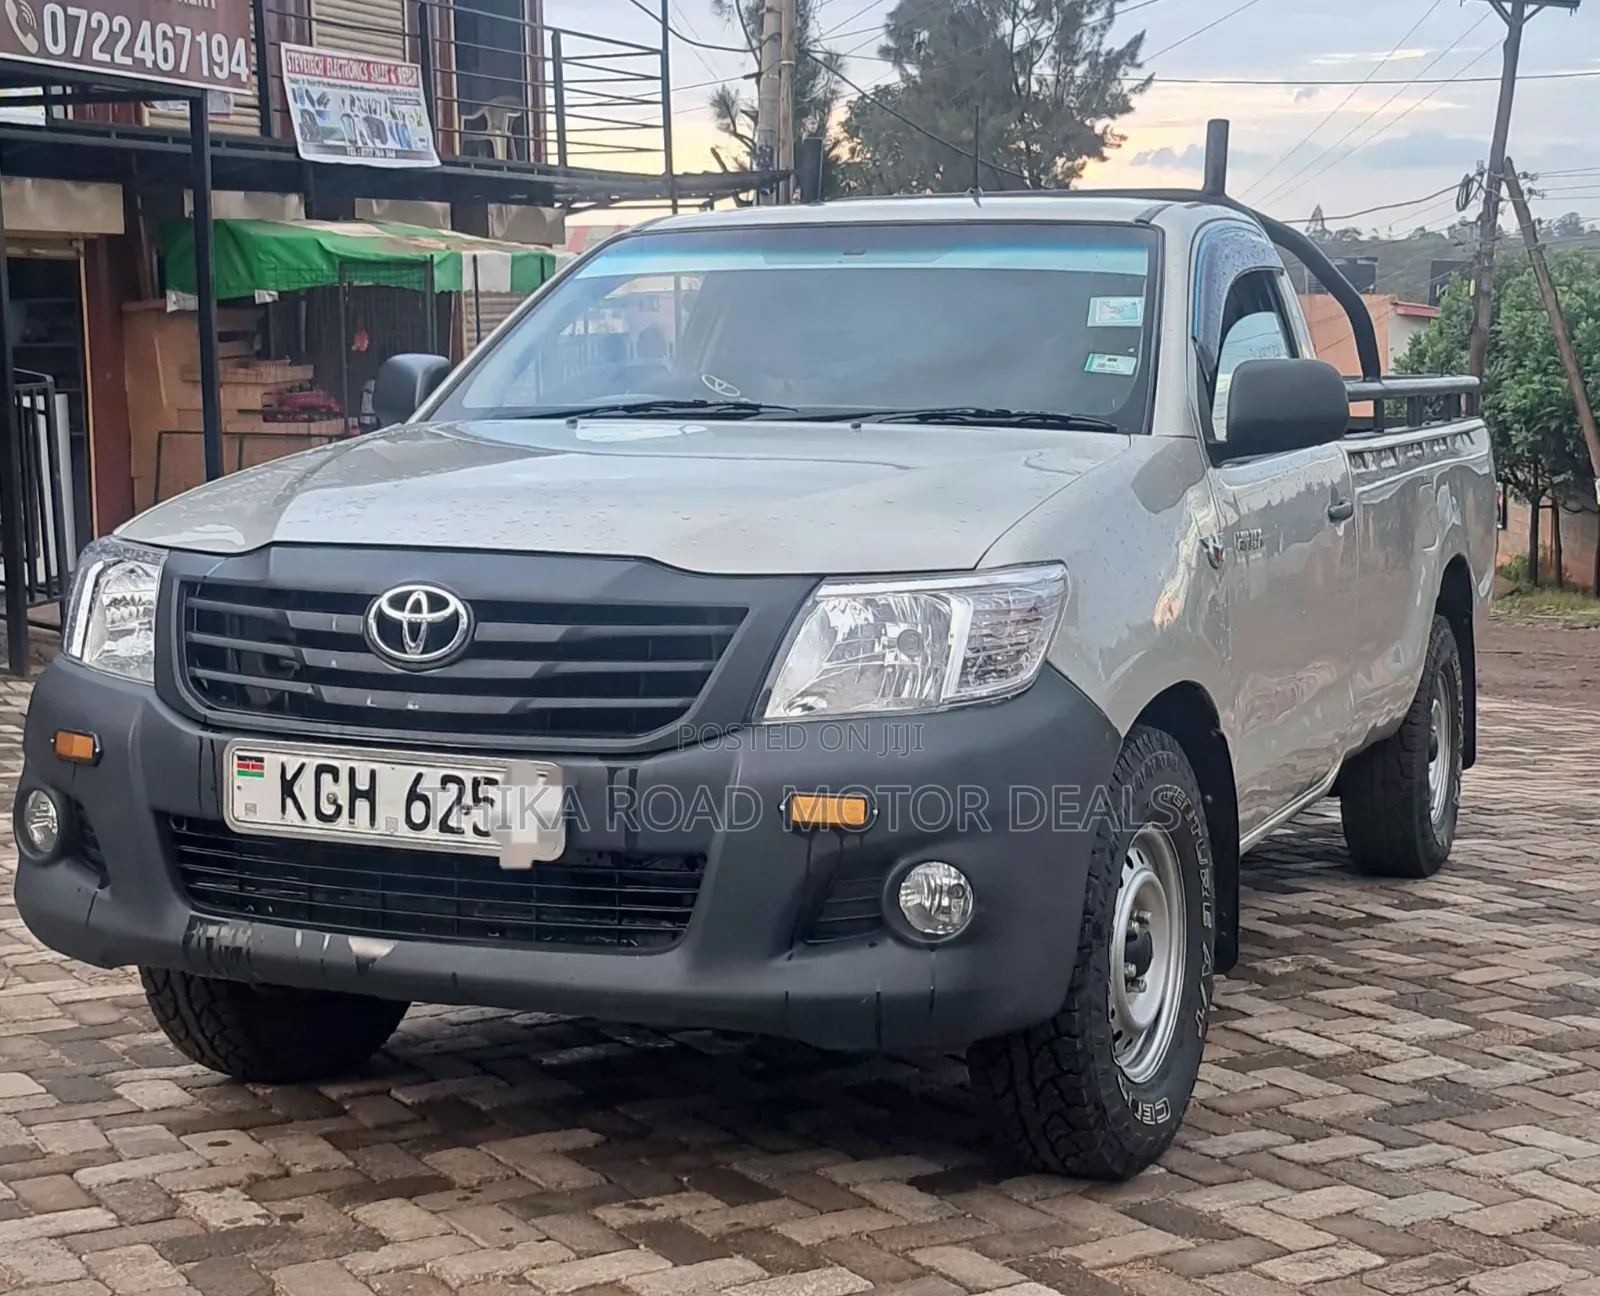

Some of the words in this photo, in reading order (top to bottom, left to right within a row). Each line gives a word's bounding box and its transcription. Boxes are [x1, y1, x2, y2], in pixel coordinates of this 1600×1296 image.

[43, 3, 250, 83] 0722467194
[286, 52, 324, 76] STEVETECH
[326, 57, 369, 81] ELECTRONICS
[370, 63, 389, 83] SALES
